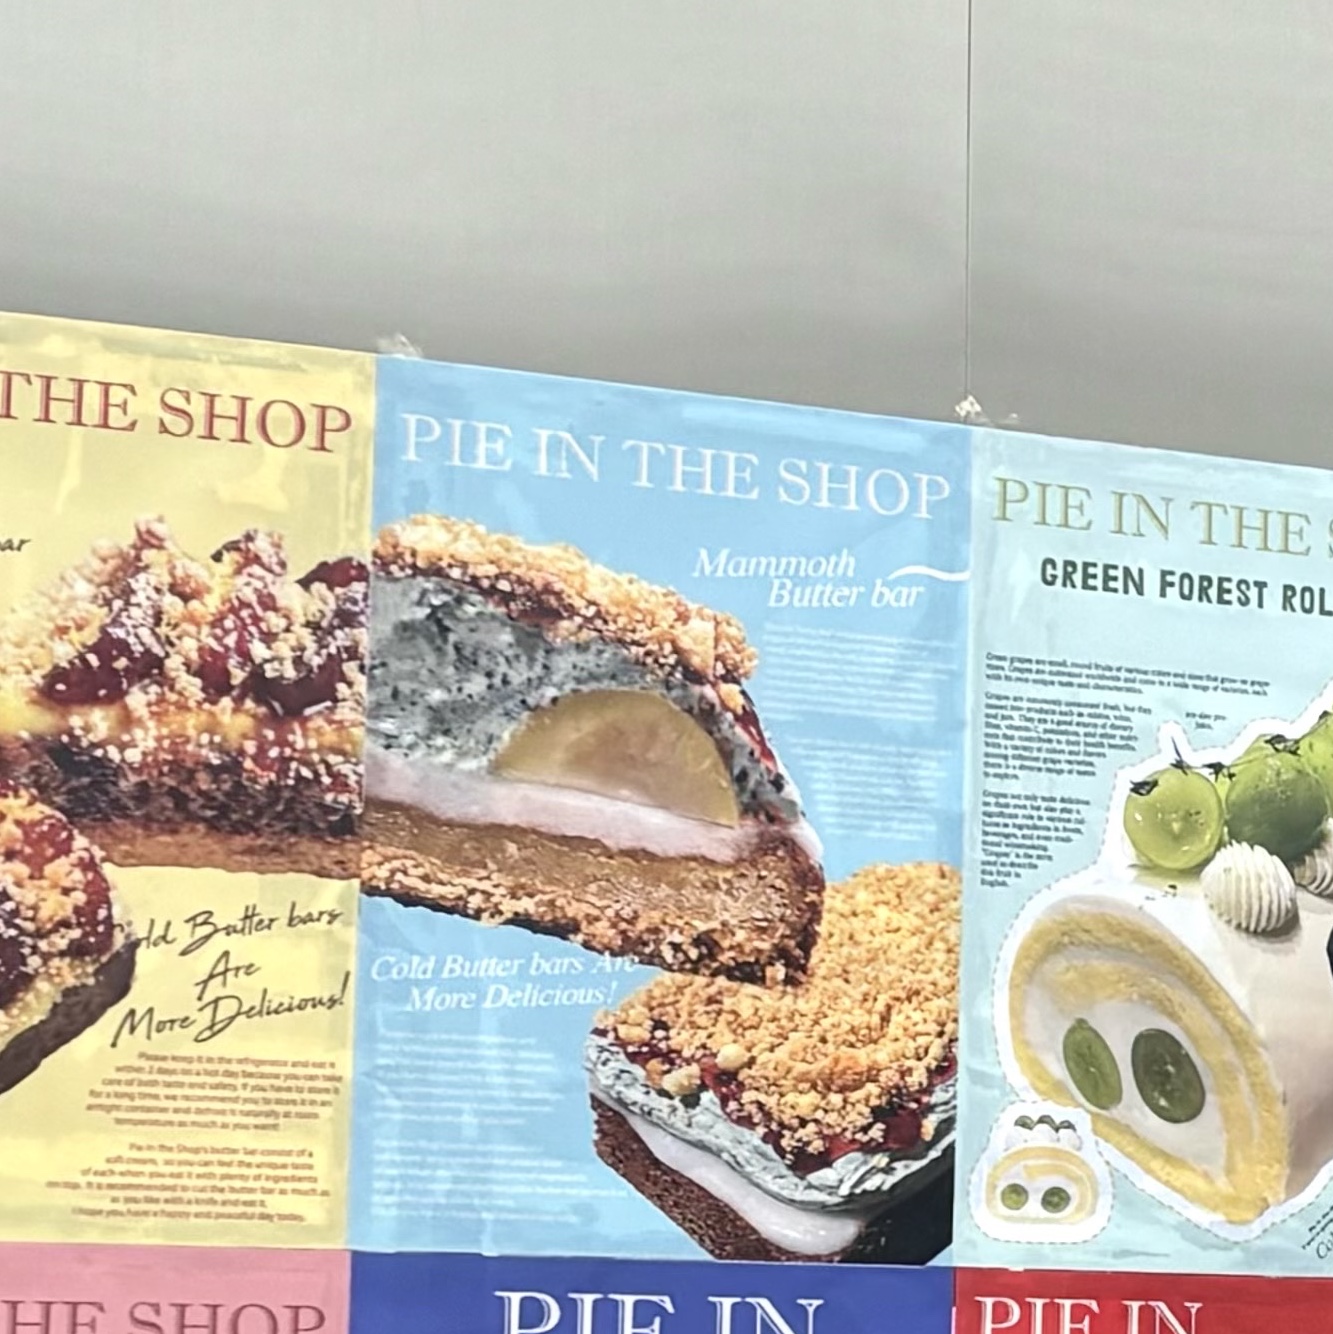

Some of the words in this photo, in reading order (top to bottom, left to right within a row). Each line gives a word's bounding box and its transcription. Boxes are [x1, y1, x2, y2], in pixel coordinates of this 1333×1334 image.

[0, 370, 137, 433] THE
[157, 386, 353, 454] SHOP
[400, 413, 512, 472] PIE
[530, 428, 606, 482] IN
[621, 441, 760, 500] THE
[777, 458, 952, 520] SHOP
[991, 476, 1094, 534] PIE
[1108, 490, 1173, 541] IN
[1189, 499, 1313, 557] THE
[0, 538, 32, 552] ar
[692, 547, 856, 578] Mammoth
[767, 577, 865, 608] Butter
[870, 578, 925, 608] bar
[1040, 555, 1146, 597] GREEN
[1157, 569, 1270, 611] FOREST
[178, 904, 280, 957] Butter
[287, 901, 344, 928] bars
[193, 950, 262, 1001] Are
[371, 954, 435, 982] Cold
[441, 953, 525, 979] Butter
[528, 951, 584, 977] bars
[592, 952, 639, 973] Are
[110, 1007, 197, 1048] More
[193, 970, 350, 1043] Delicious!
[405, 985, 477, 1011] More
[481, 981, 618, 1009] Delicious!
